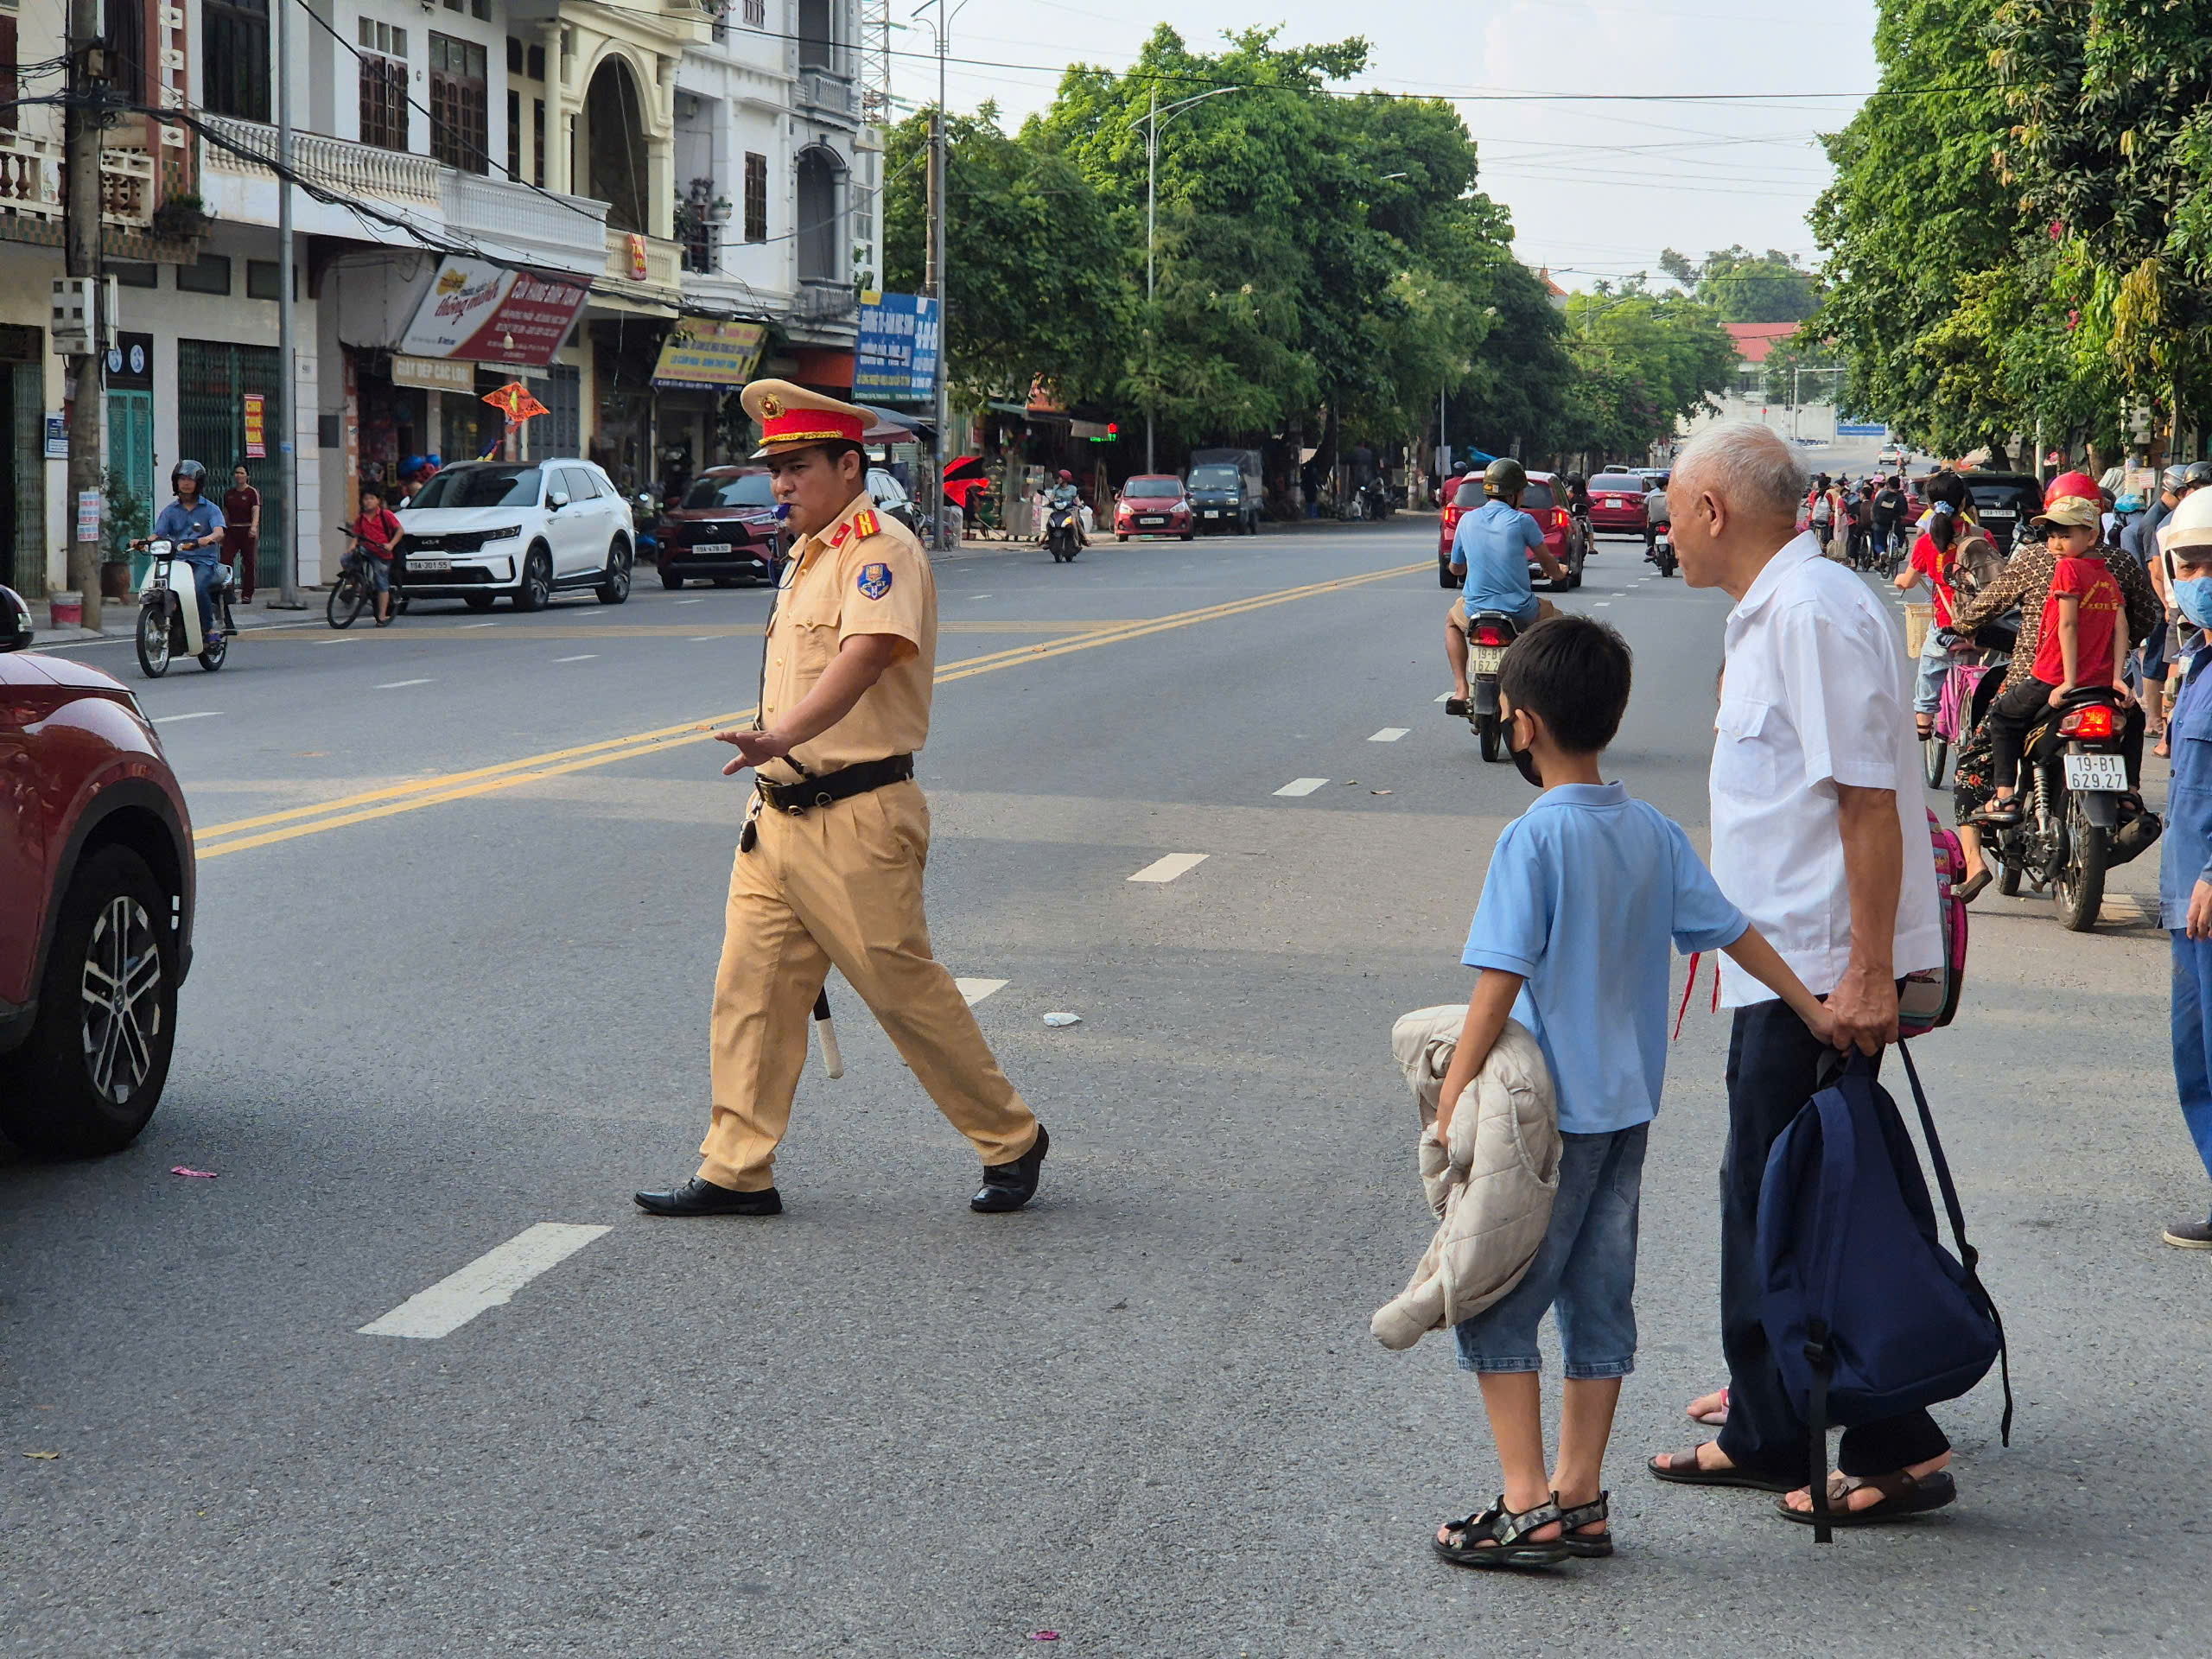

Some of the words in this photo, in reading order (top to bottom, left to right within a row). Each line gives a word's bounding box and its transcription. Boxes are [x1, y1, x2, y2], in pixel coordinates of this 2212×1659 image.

[1478, 648, 1502, 660] 19-B1
[1472, 660, 1500, 672] 162.2
[2076, 757, 2115, 772] 19-B1
[2072, 773, 2122, 789] 629.27
